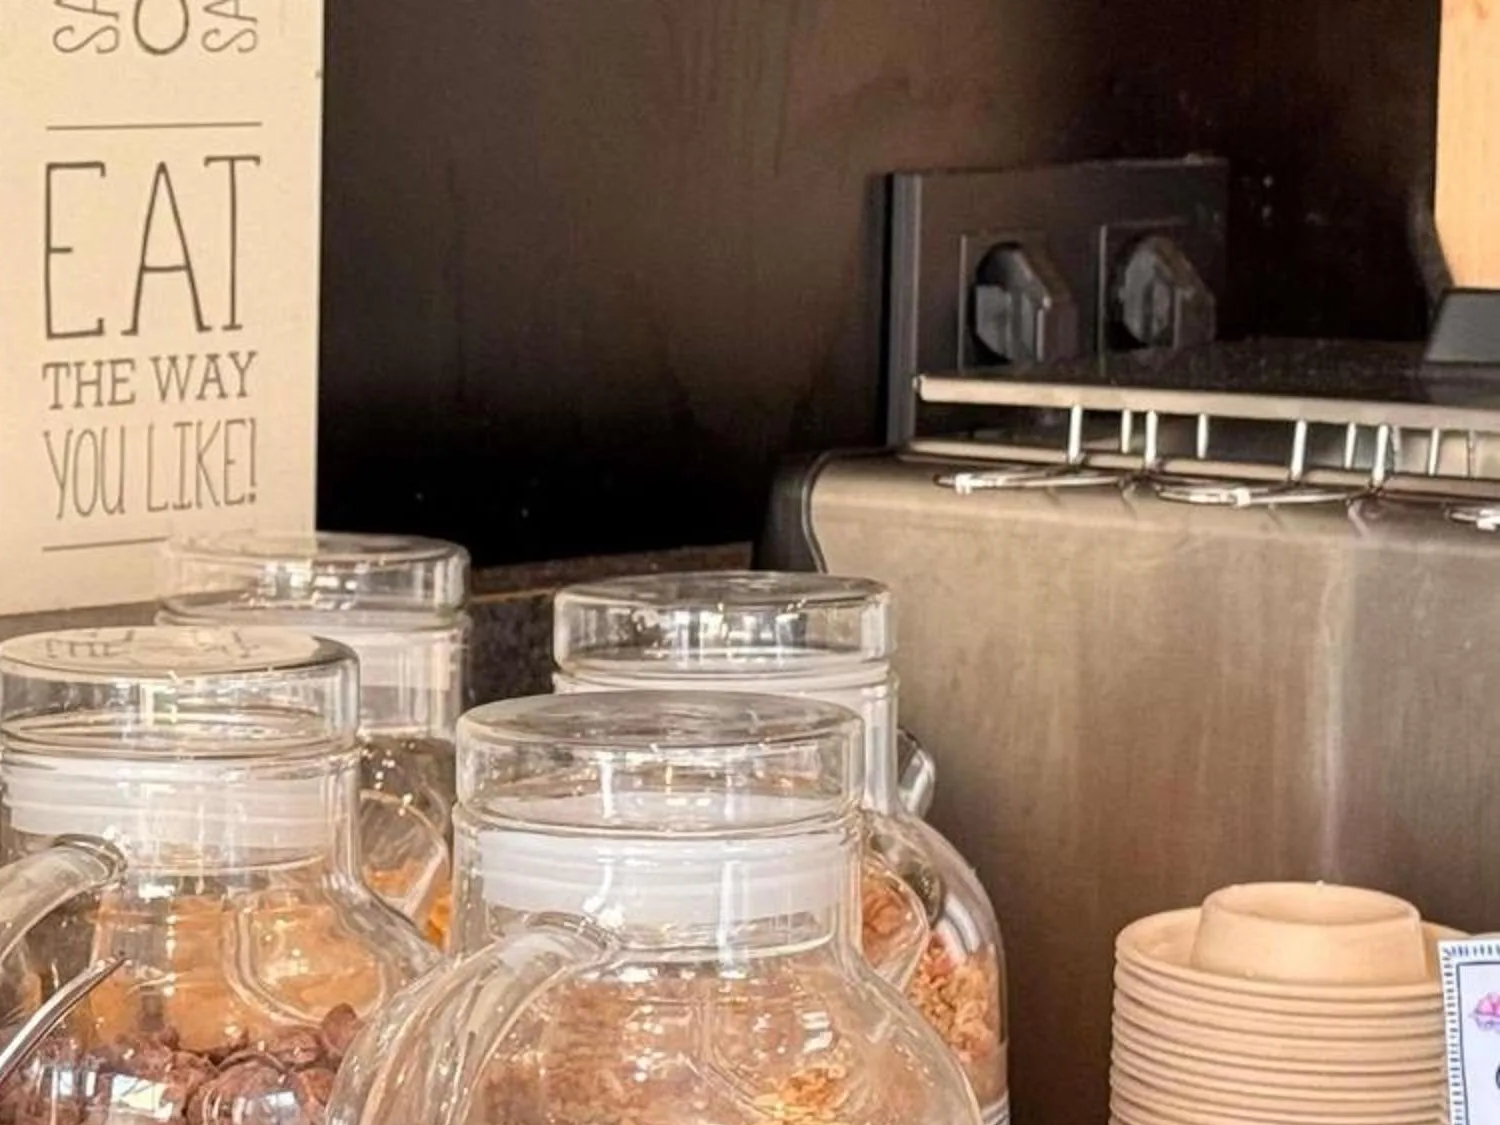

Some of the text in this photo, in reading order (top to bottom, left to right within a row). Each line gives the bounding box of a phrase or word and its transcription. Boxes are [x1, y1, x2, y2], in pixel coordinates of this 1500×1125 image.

[45, 155, 261, 340] EAT
[42, 350, 258, 411] THE WAY
[43, 417, 257, 520] YOU LIKE!
